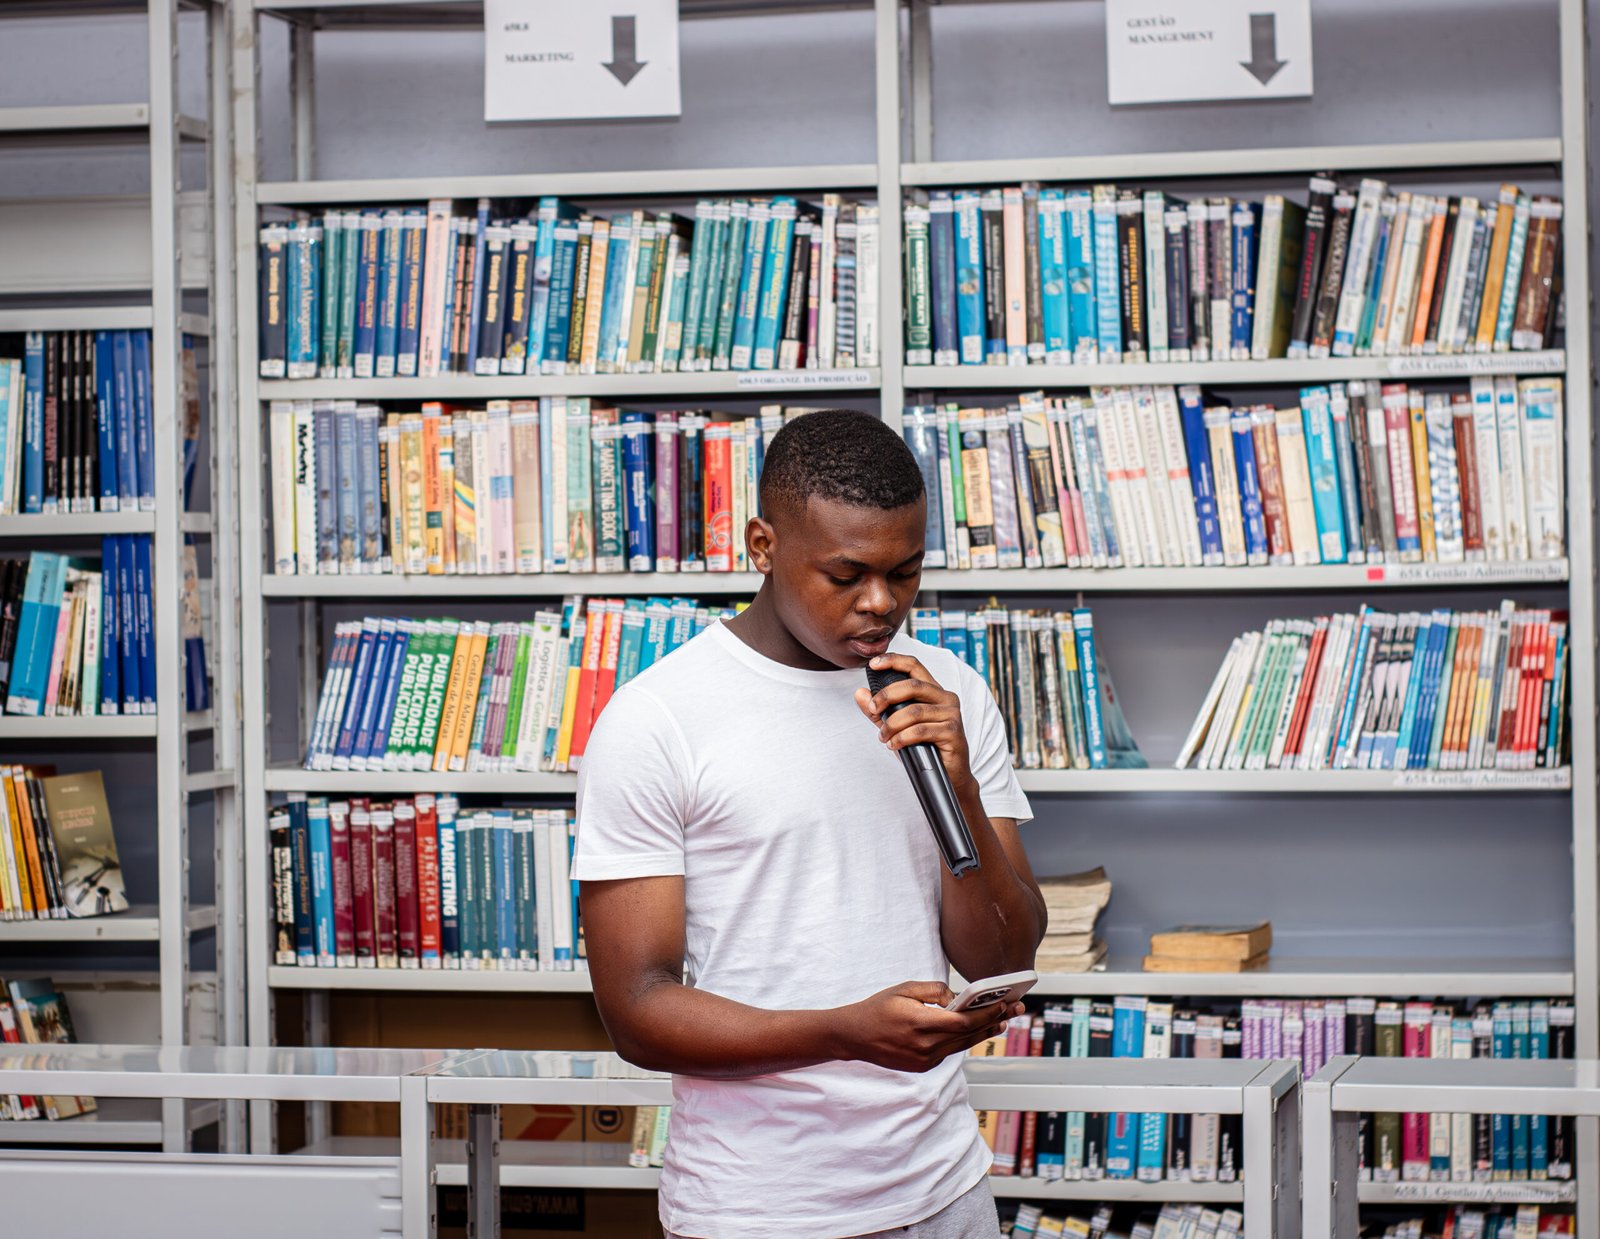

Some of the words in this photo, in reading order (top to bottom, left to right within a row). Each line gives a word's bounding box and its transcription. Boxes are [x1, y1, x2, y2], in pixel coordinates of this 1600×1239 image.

[1127, 15, 1176, 28] GESTÃO
[1128, 31, 1215, 44] MANAGEMENT
[505, 52, 575, 63] MARKETING
[514, 255, 528, 291] Creating
[576, 246, 589, 300] MANAGING
[915, 240, 926, 294] MANAGEMENT
[1129, 228, 1139, 283] INTERNATIONAL
[1327, 216, 1348, 299] MANAGEMENT
[572, 300, 586, 355] INNOVATION
[916, 295, 926, 325] POLICY
[1131, 284, 1141, 333] MANAGEMENT
[818, 373, 868, 385] PRODUÇÃO
[296, 424, 309, 485] Marketing
[1102, 409, 1120, 469] ANAGEMENT
[599, 447, 617, 511] MARKETING
[600, 511, 616, 541] BOOK
[1425, 566, 1467, 580] Gestão
[452, 655, 465, 689] Gestão
[468, 655, 481, 689] Gestão
[536, 640, 554, 692] Logística
[974, 643, 986, 673] Gestão
[1081, 641, 1094, 671] Gestão
[388, 654, 419, 748] PUBLICIDADE
[402, 654, 432, 748] PUBLICIDADE
[420, 654, 451, 748] PUBLICIDADE
[450, 690, 459, 702] de
[465, 690, 474, 702] de
[1086, 672, 1096, 689] das
[441, 704, 456, 740] Marcas
[457, 704, 472, 740] Marcas
[531, 701, 544, 743] Gestão
[1086, 690, 1101, 747] Organizações
[296, 828, 308, 876] Consumer
[440, 828, 458, 917] MARKETING
[298, 876, 310, 914] Behavior
[423, 837, 438, 921] PRINCIPLES
[465, 857, 473, 902] e-commerce
[484, 857, 492, 901] e-commerce
[522, 857, 530, 901] e-commerce
